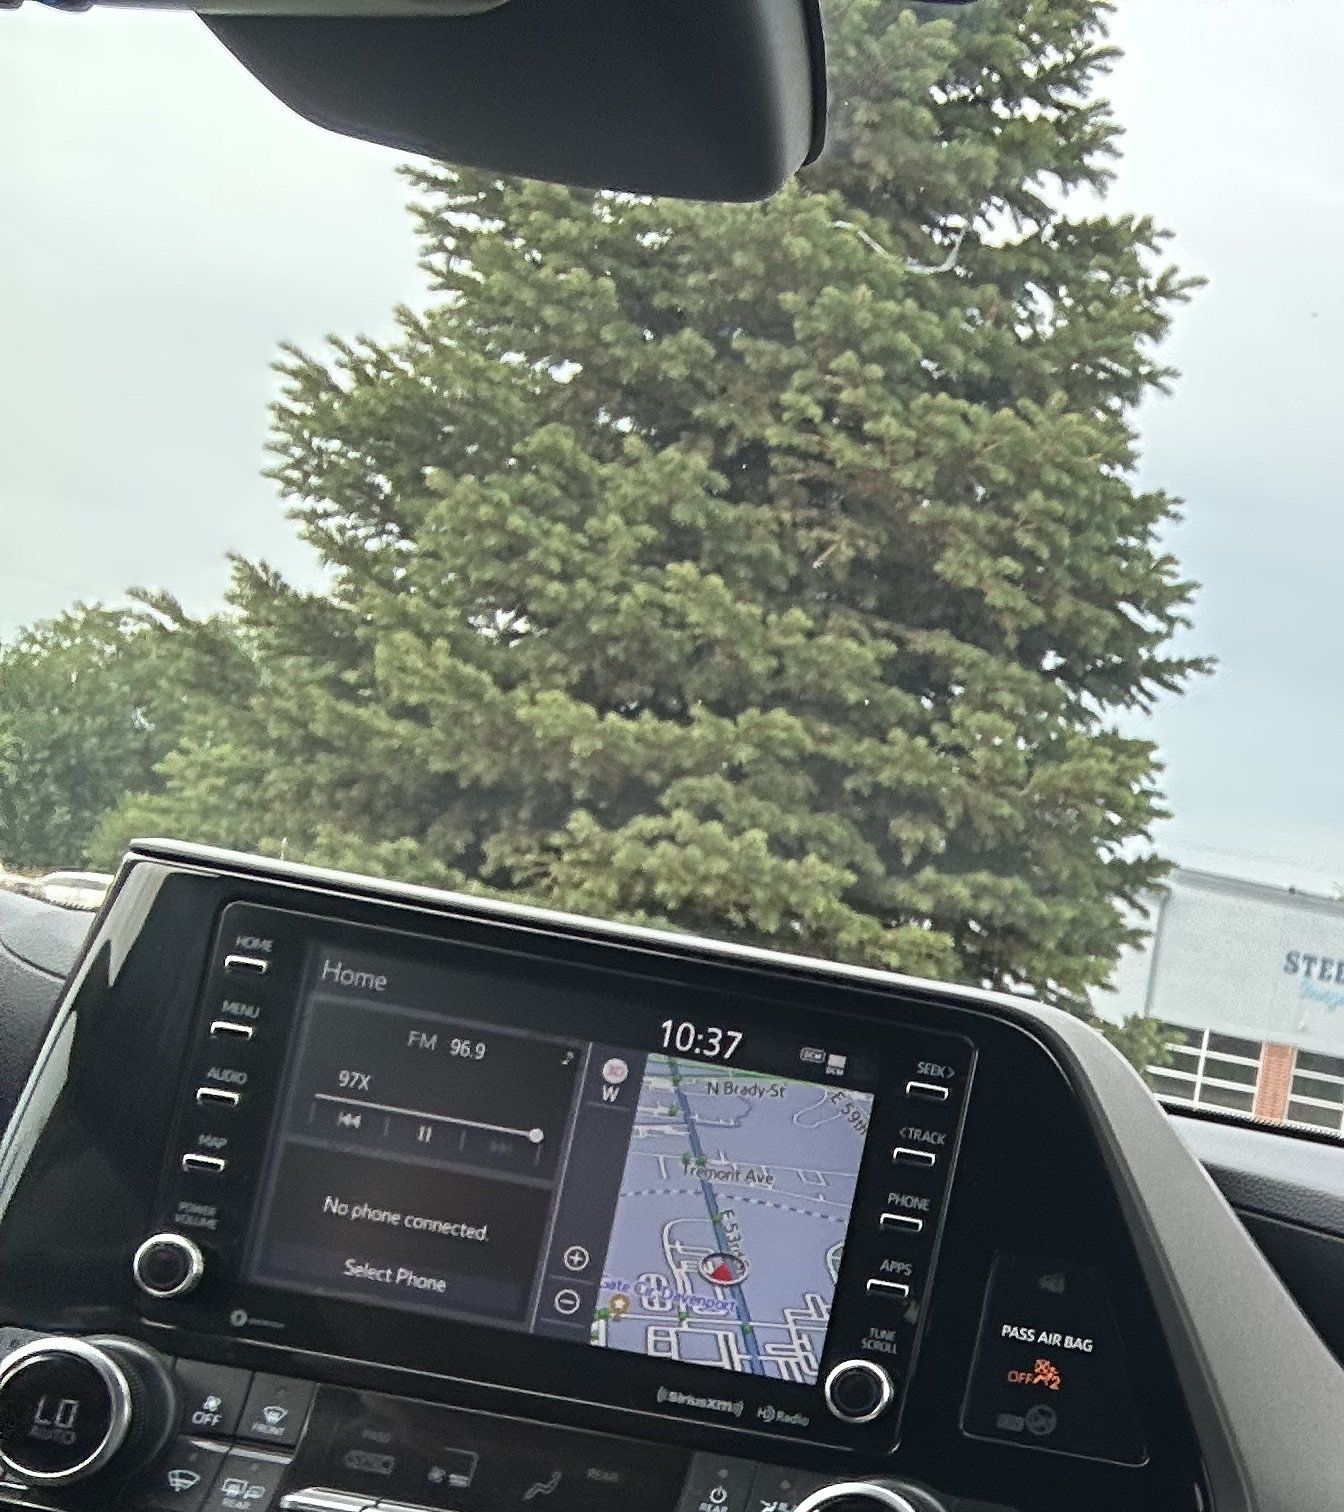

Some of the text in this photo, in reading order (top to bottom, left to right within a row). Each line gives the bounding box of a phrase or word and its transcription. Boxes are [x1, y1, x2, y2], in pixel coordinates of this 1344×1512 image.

[235, 934, 273, 953] HOME
[321, 959, 388, 991] Home
[222, 1000, 260, 1019] MENU
[407, 1030, 486, 1060] FM 96.9
[662, 1019, 744, 1060] 10:37
[207, 1066, 248, 1086] AUDIO
[917, 1060, 945, 1078] SEEK
[338, 1069, 372, 1091] 97X
[707, 1080, 786, 1099] N Brady St
[602, 1084, 620, 1102] W
[831, 1091, 844, 1104] E
[909, 1127, 948, 1146] TRACK
[682, 1163, 774, 1185] Tremont Ave
[888, 1192, 931, 1212] PHONE
[323, 1195, 489, 1242] No phone connected.
[343, 1258, 448, 1293] Select Phone
[880, 1259, 913, 1276] APPS
[1001, 1324, 1093, 1352] PASS AIR BAG
[1007, 1370, 1034, 1384] OFF
[191, 1411, 222, 1427] OFF
